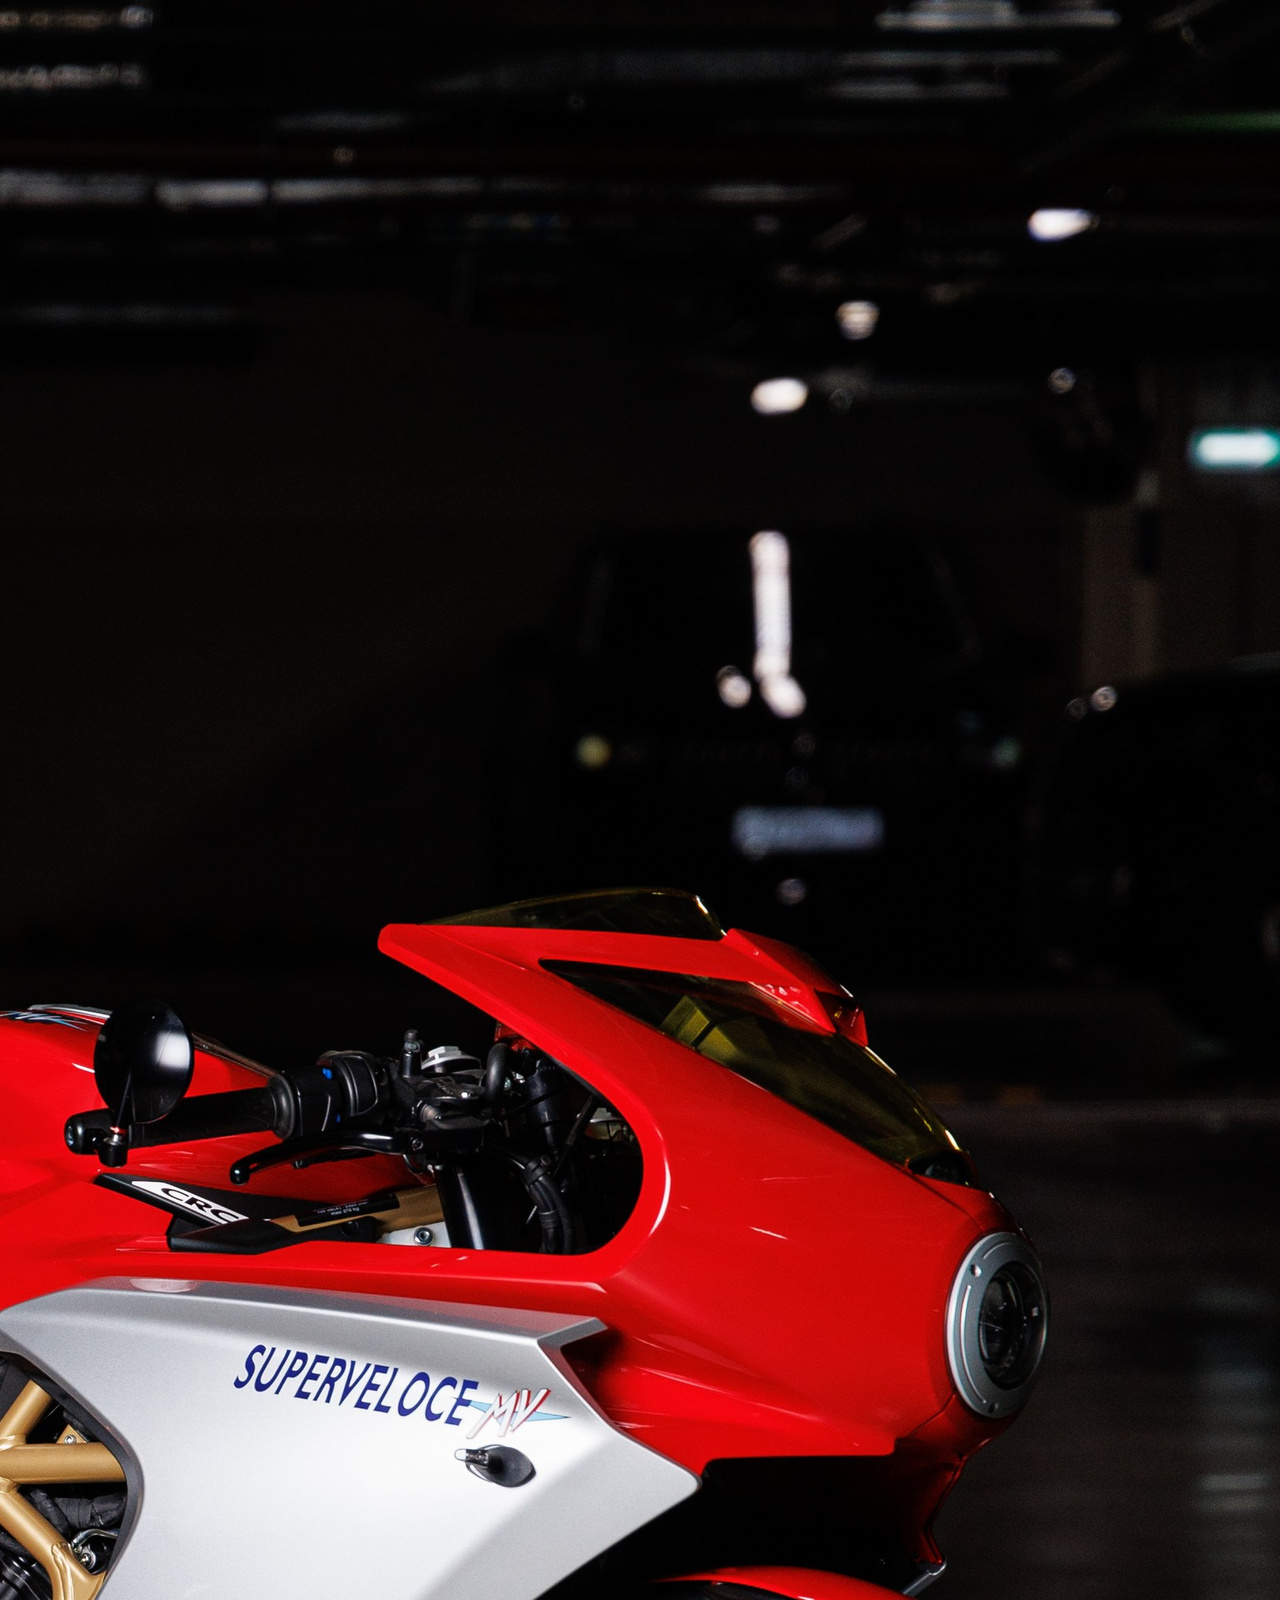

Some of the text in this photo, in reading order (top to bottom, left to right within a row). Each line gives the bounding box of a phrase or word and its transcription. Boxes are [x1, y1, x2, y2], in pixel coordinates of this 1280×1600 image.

[161, 1187, 240, 1223] CRC
[234, 1344, 551, 1439] SUPERVELOCE MV
